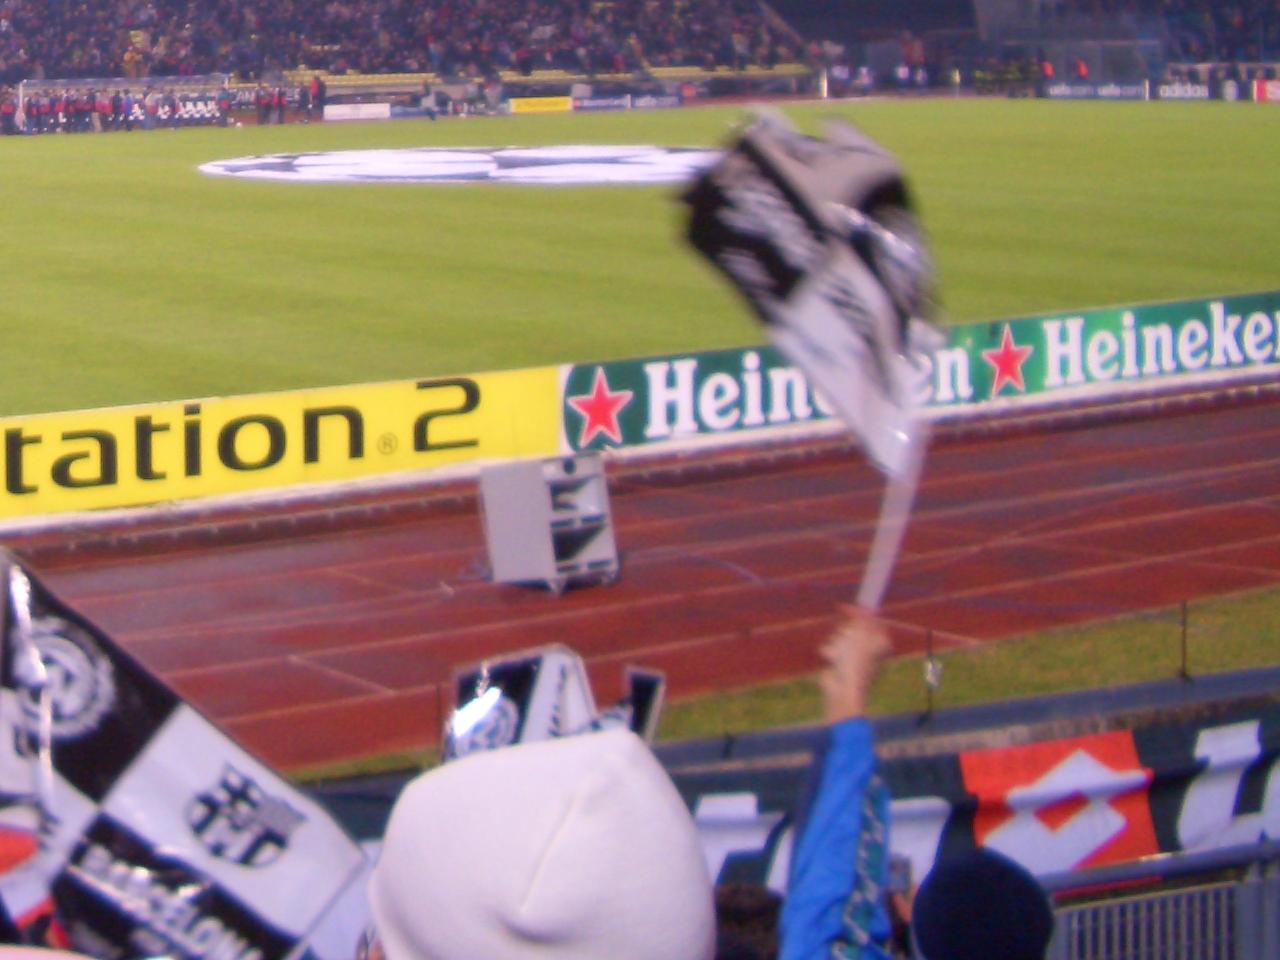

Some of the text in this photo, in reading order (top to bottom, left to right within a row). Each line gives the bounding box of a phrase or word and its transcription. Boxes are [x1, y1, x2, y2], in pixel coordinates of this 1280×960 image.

[1043, 302, 1280, 389] Heineke
[413, 377, 482, 453] 2
[644, 347, 973, 438] Heinen
